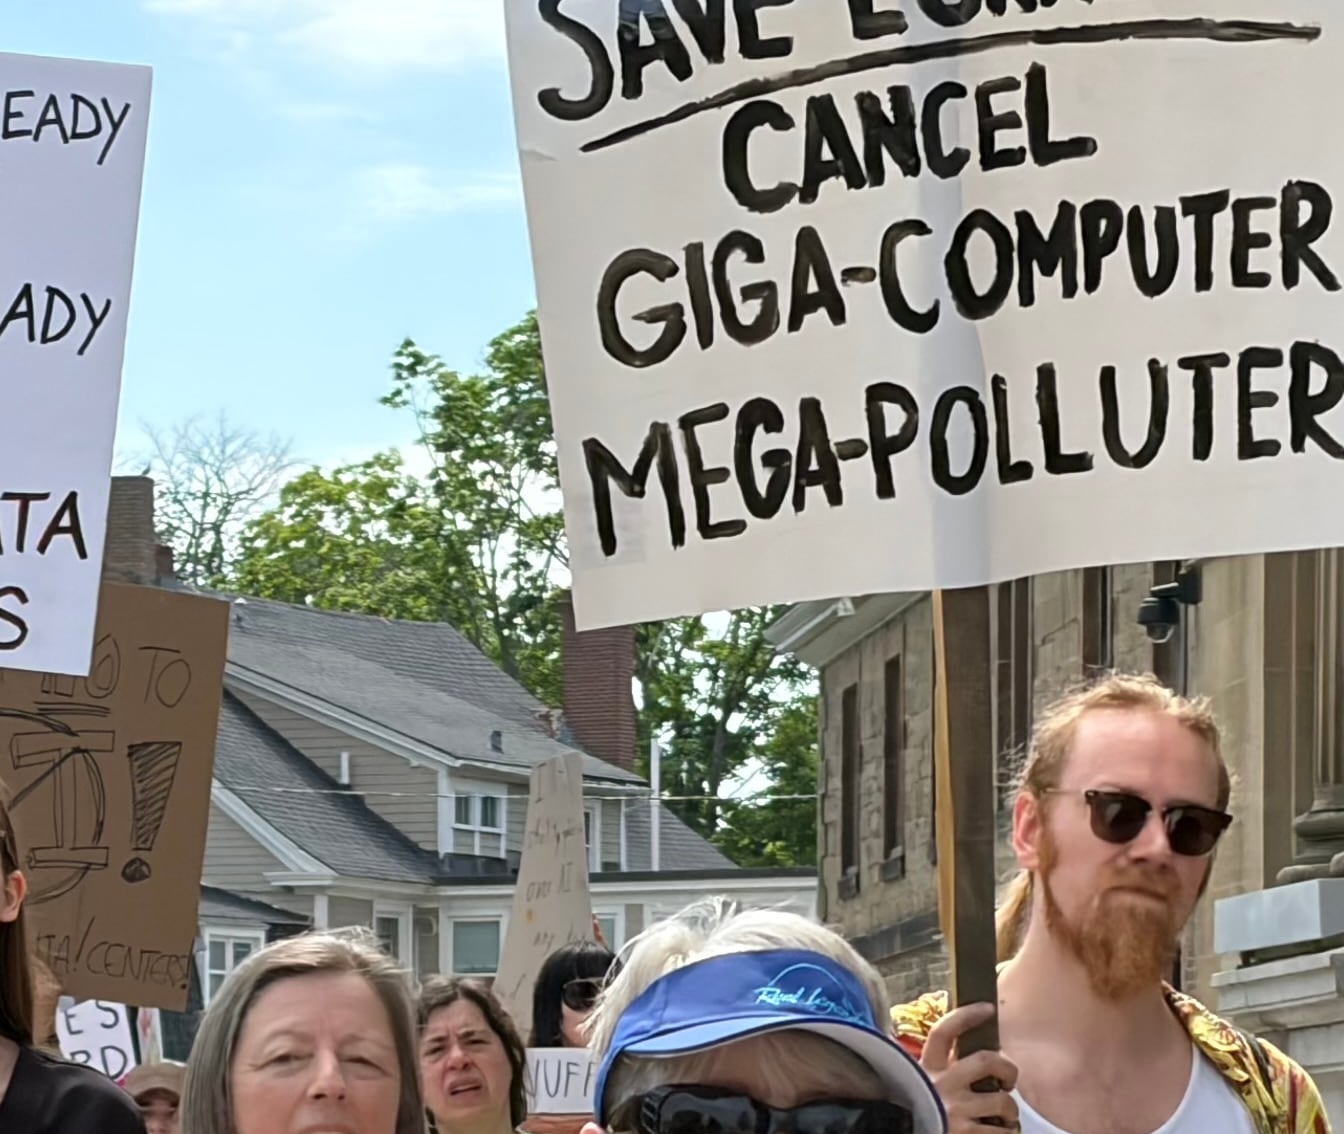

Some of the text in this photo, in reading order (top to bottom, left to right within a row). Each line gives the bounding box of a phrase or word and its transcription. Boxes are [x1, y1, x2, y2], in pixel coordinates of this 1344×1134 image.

[721, 61, 1099, 213] CANCEL
[596, 178, 1343, 369] GIGA-COMPUTER
[138, 646, 192, 708] TO
